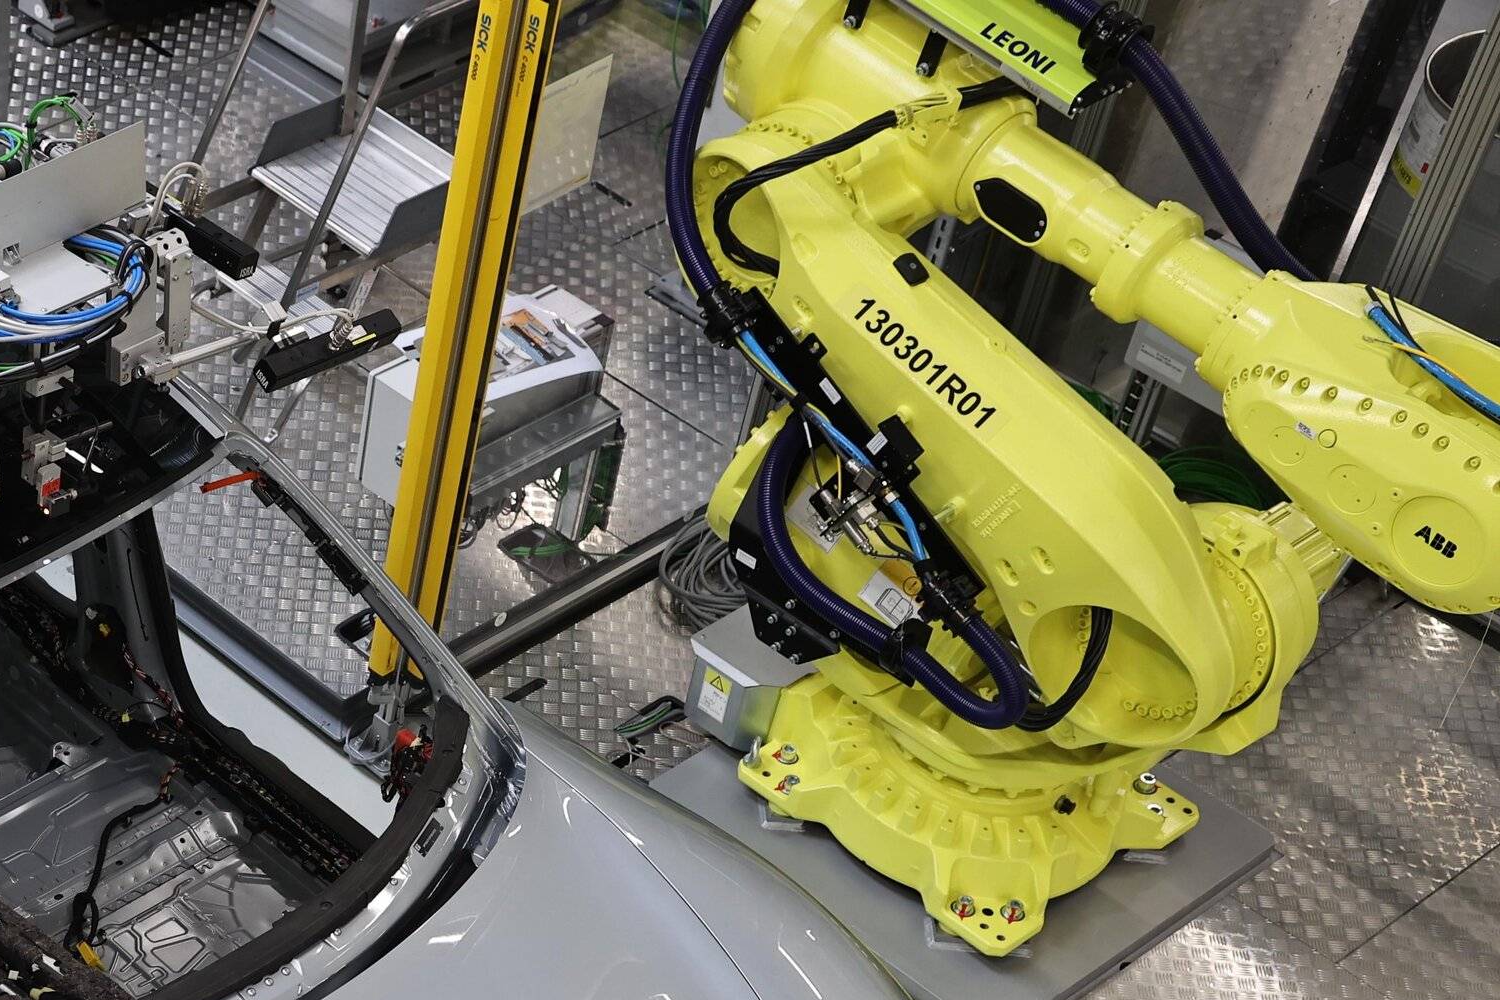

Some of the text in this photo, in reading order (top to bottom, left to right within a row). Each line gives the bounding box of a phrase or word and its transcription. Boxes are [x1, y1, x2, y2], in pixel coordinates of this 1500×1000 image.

[476, 13, 491, 53] SICK
[525, 14, 540, 54] SICK
[980, 22, 1057, 74] LEONI
[255, 369, 270, 389] ISRA
[854, 298, 997, 429] 130301R01
[1413, 525, 1458, 559] ABB
